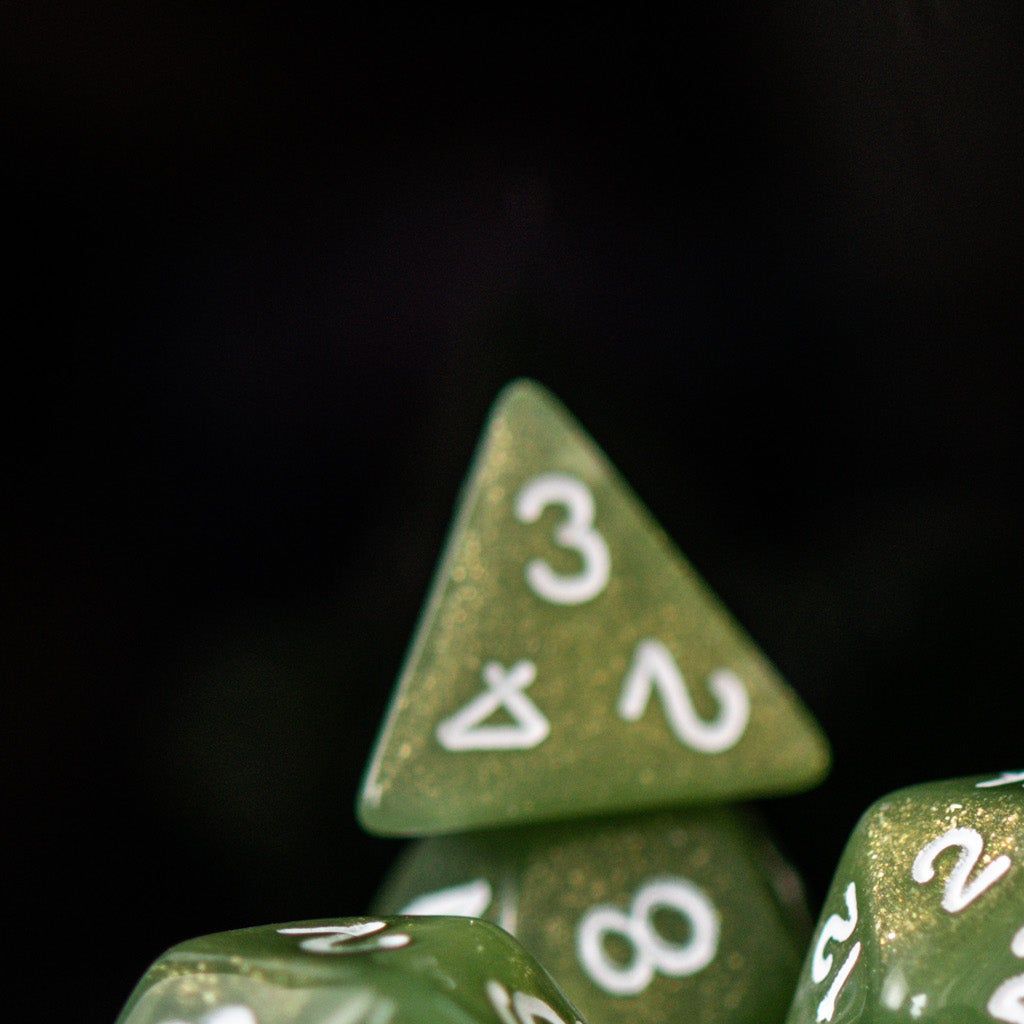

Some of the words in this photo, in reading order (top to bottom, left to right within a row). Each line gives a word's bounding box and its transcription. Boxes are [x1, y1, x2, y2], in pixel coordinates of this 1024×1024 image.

[515, 472, 611, 605] 3
[436, 660, 550, 752] 4
[618, 639, 751, 754] 2
[910, 824, 1013, 914] 2
[576, 878, 720, 996] 8
[810, 882, 862, 1024] 12
